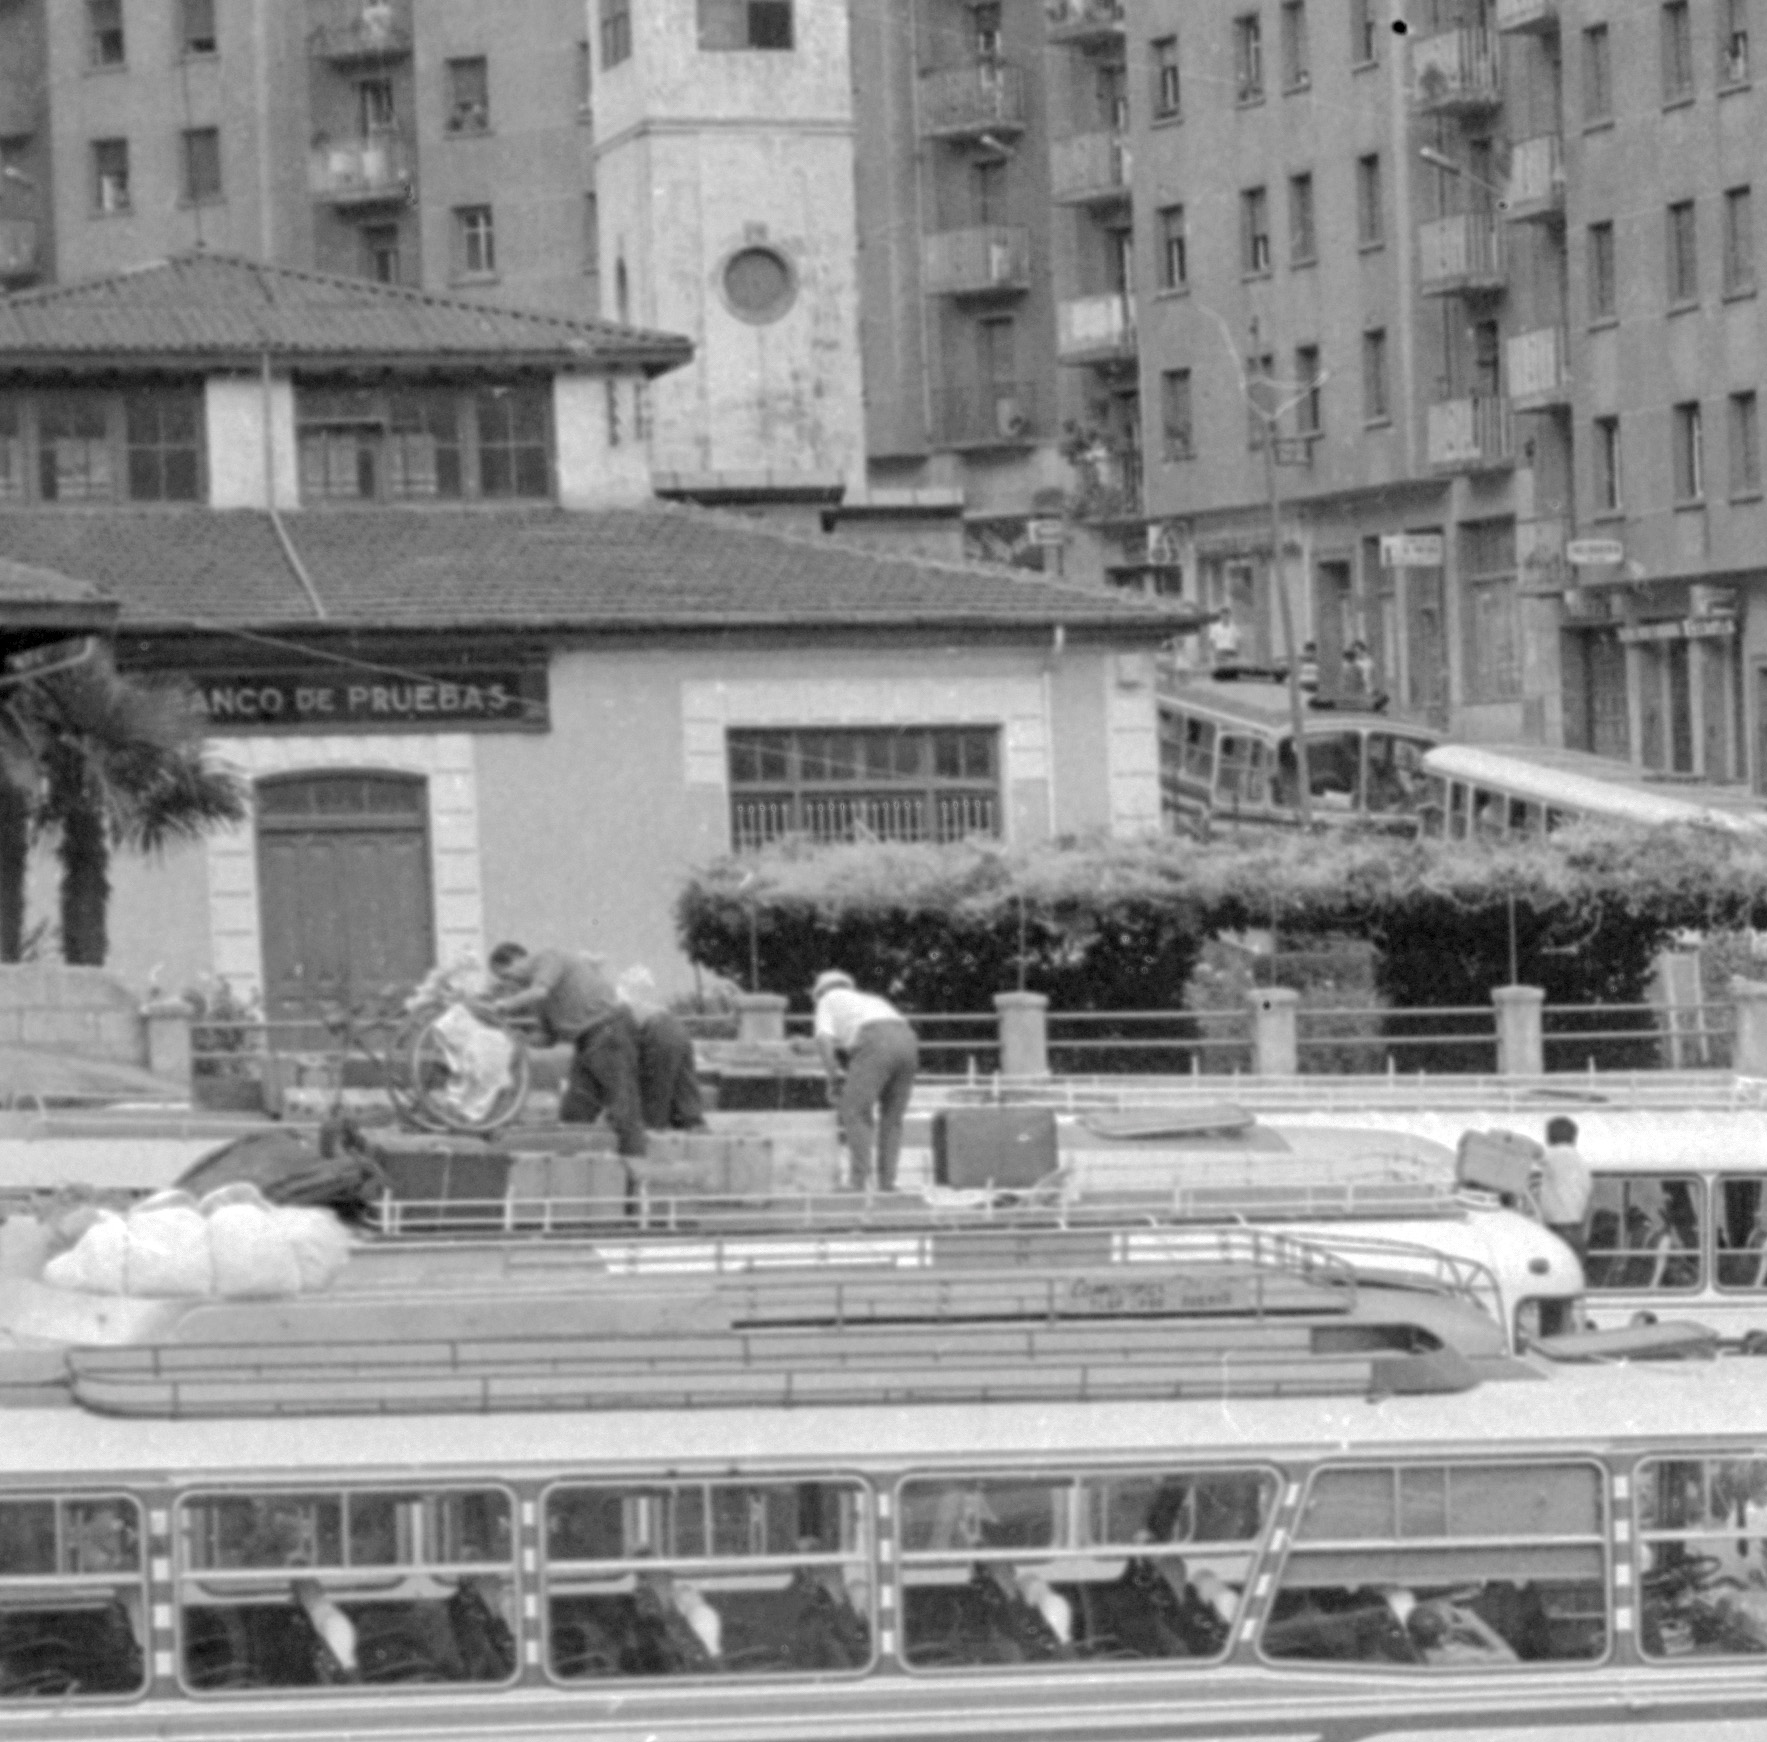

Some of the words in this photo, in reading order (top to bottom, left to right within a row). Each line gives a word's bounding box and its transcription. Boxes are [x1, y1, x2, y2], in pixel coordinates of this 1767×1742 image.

[184, 686, 284, 715] ANCO
[295, 687, 335, 712] DE
[348, 684, 508, 713] PRUEBAS
